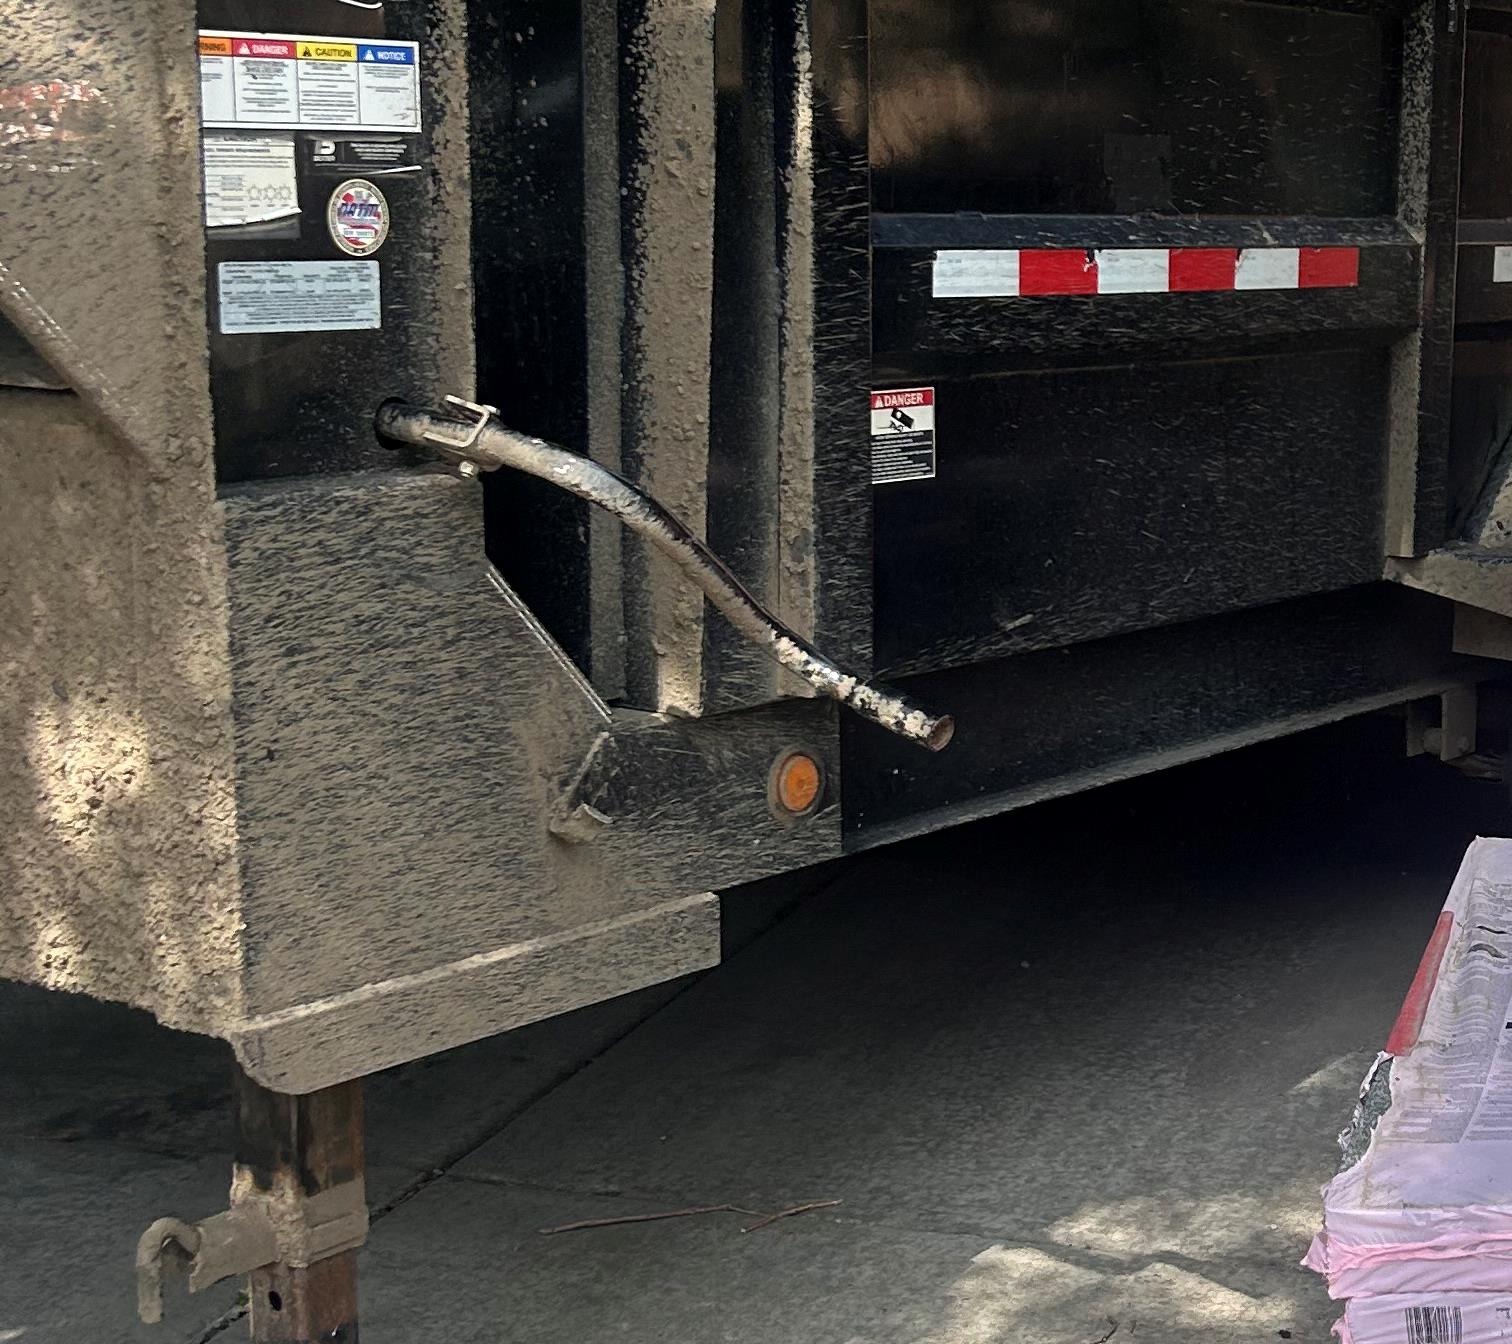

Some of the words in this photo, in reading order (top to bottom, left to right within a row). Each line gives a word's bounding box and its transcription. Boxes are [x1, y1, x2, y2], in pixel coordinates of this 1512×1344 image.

[252, 44, 289, 55] DANGER
[315, 48, 352, 58] CAUTION
[377, 51, 406, 61] NOTICE
[884, 393, 924, 407] DANGER
